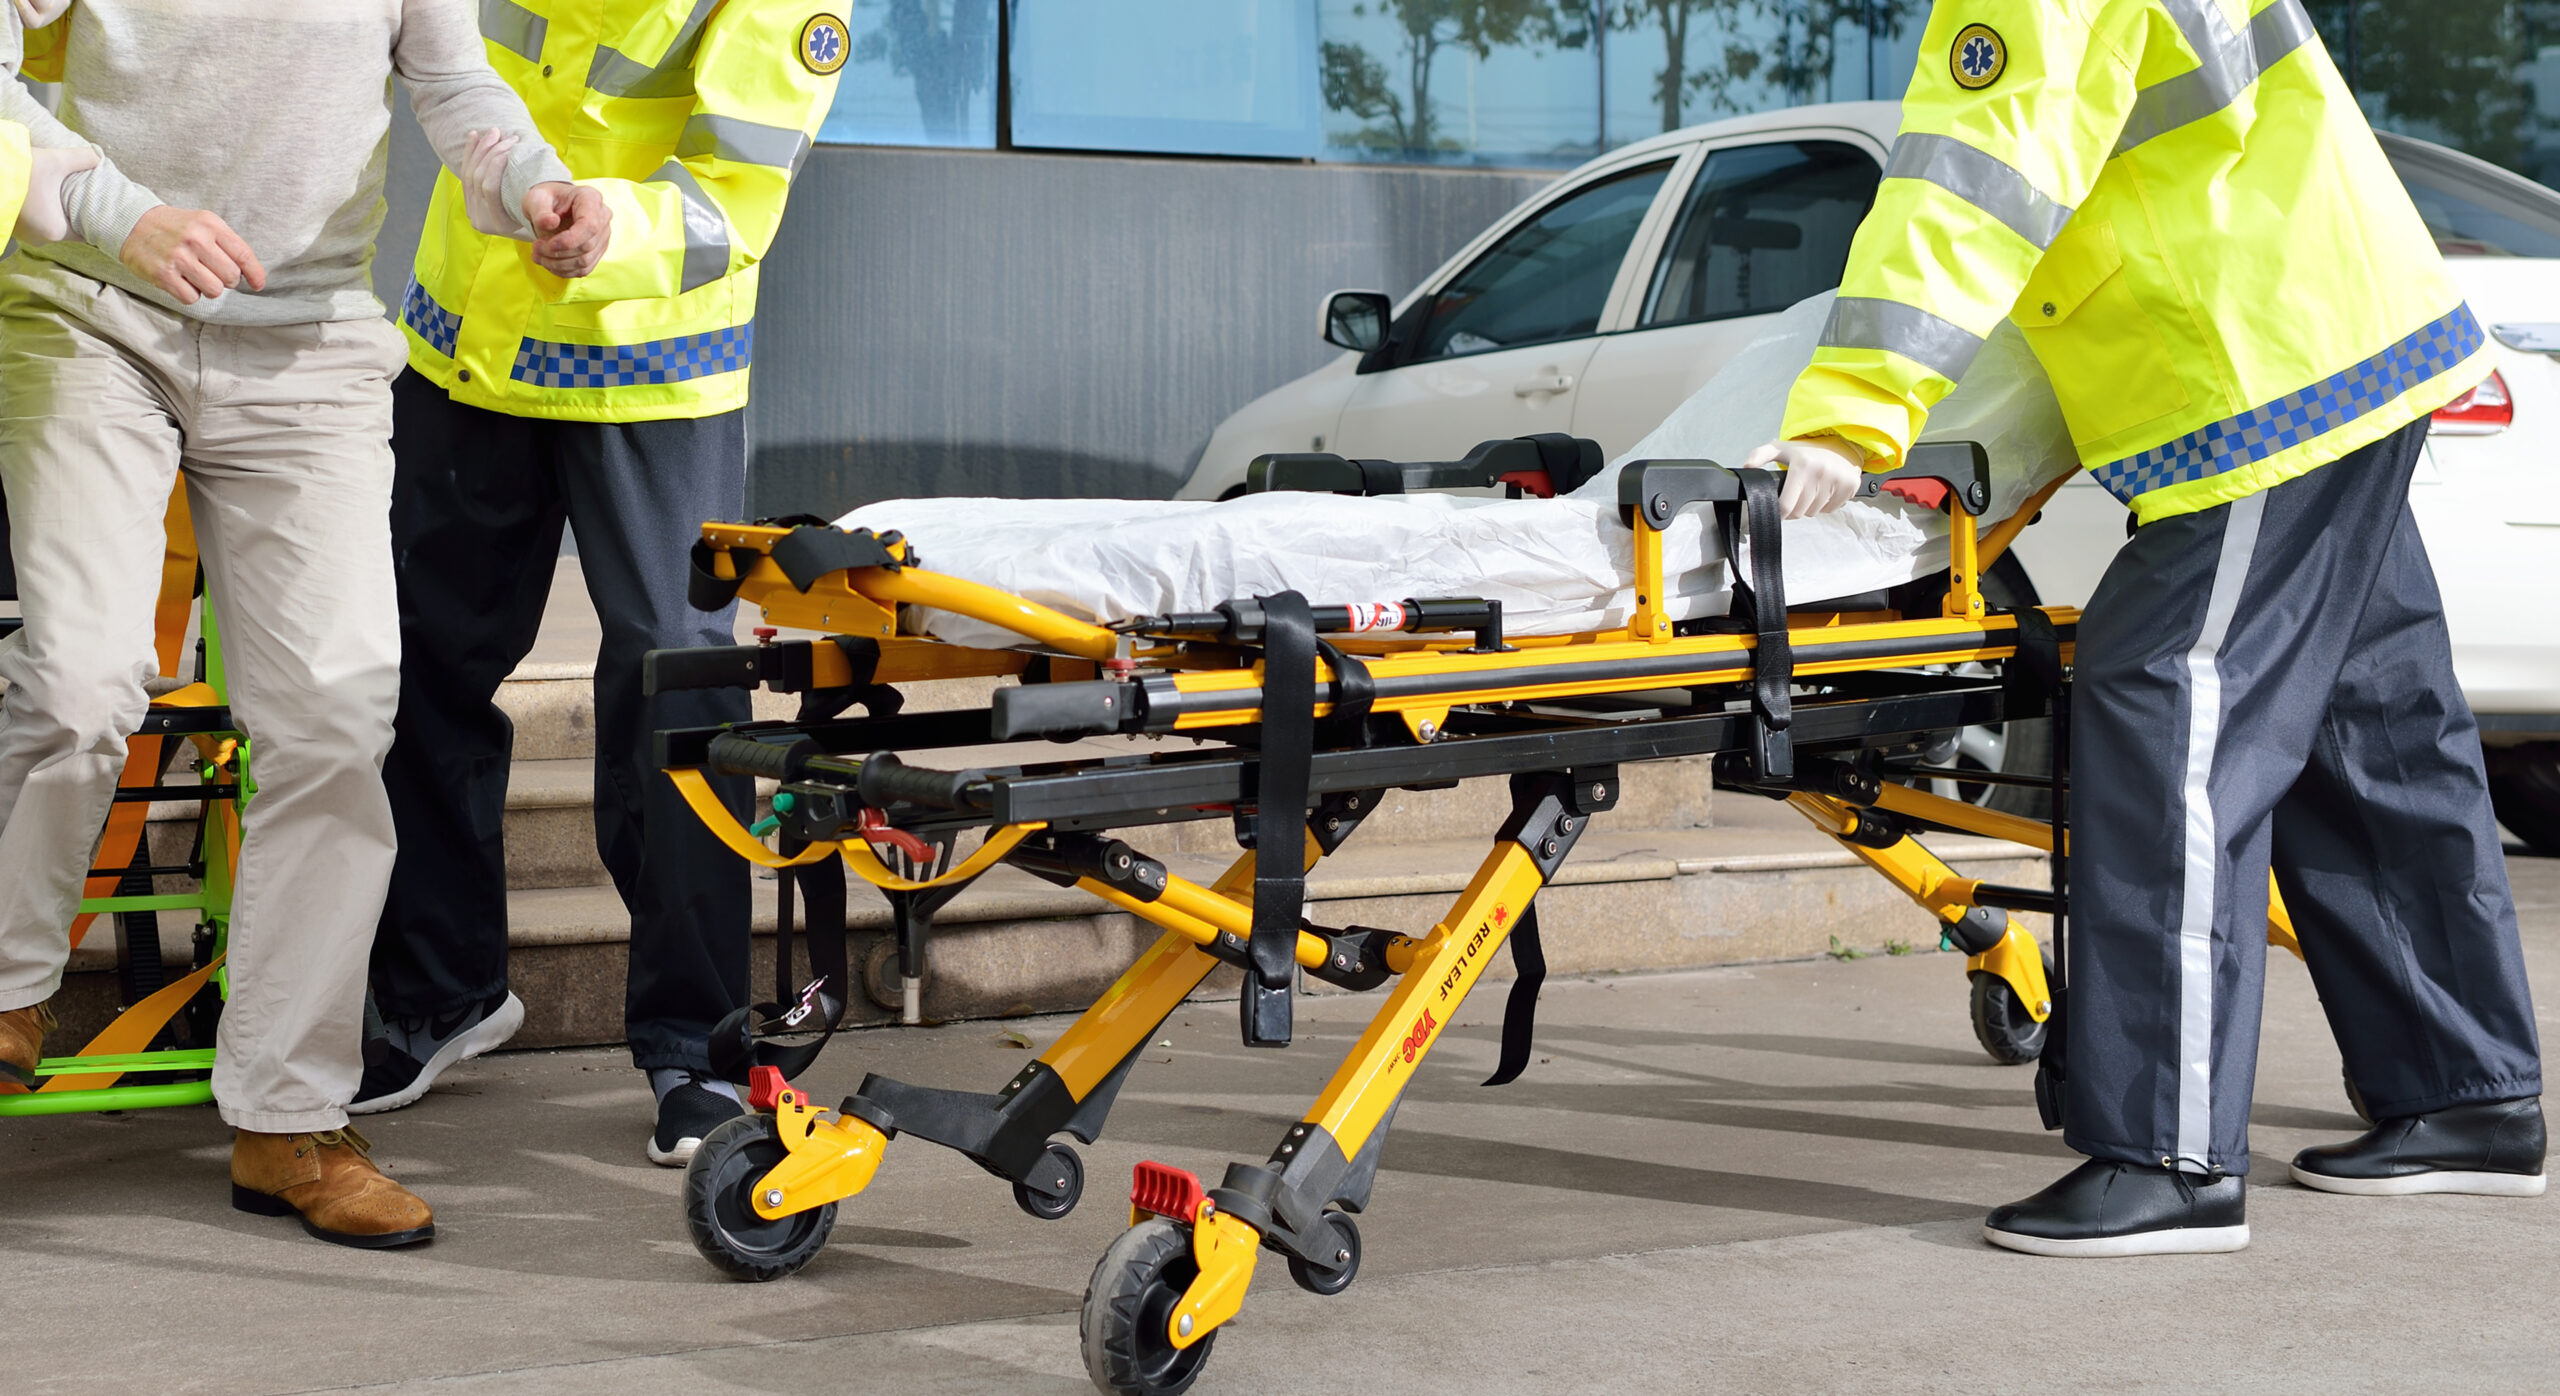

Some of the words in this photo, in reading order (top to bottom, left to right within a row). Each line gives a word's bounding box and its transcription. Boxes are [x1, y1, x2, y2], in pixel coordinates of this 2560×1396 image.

[1467, 921, 1491, 958] RED
[1440, 957, 1468, 1002] LEAF
[1402, 1008, 1437, 1063] YDC
